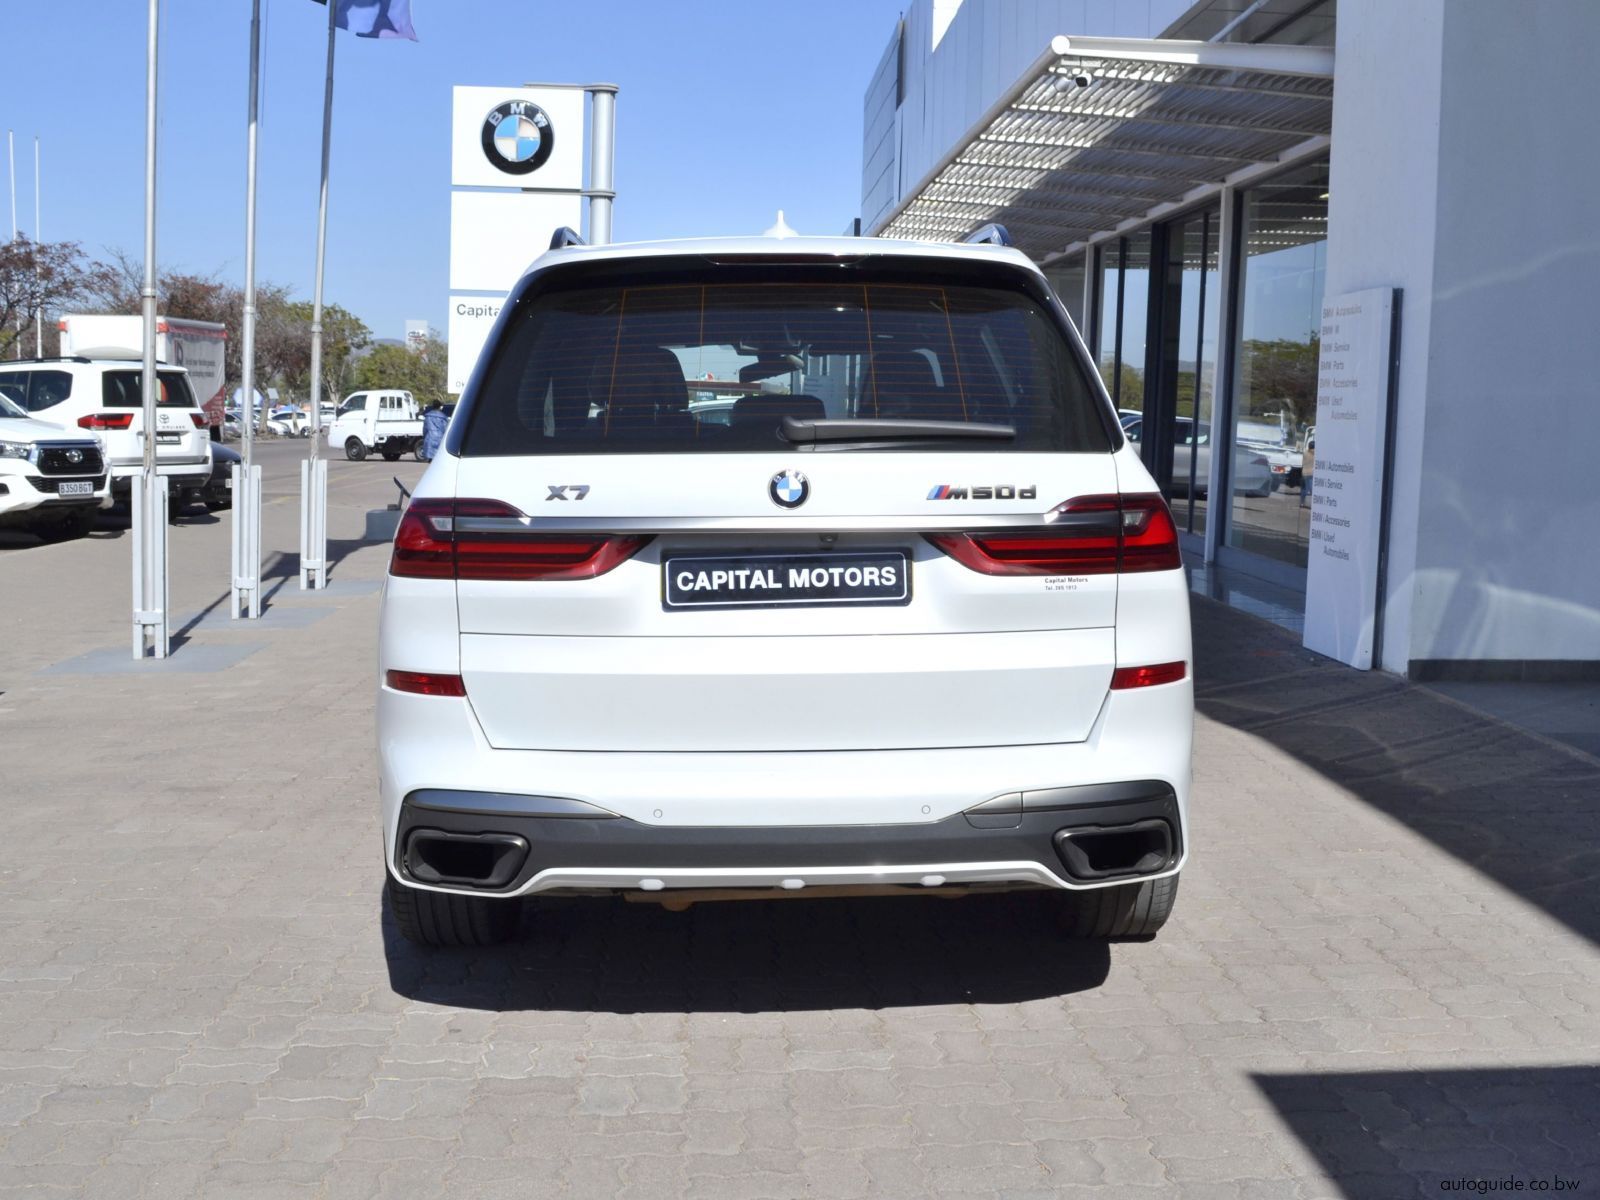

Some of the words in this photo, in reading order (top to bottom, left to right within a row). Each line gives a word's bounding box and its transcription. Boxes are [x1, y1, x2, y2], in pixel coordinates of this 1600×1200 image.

[488, 102, 549, 128] BMW
[1334, 342, 1350, 352] Service
[1333, 360, 1344, 370] Parts
[1328, 461, 1354, 473] Automobiles
[1327, 478, 1343, 490] Service
[545, 485, 590, 501] X7
[926, 484, 1037, 500] M50d
[1326, 496, 1337, 507] Parts
[1325, 514, 1351, 528] Accessories
[1324, 531, 1335, 543] Used
[1323, 545, 1350, 560] Automobiles
[676, 569, 782, 591] CAPITAL
[788, 567, 897, 588] MOTORS
